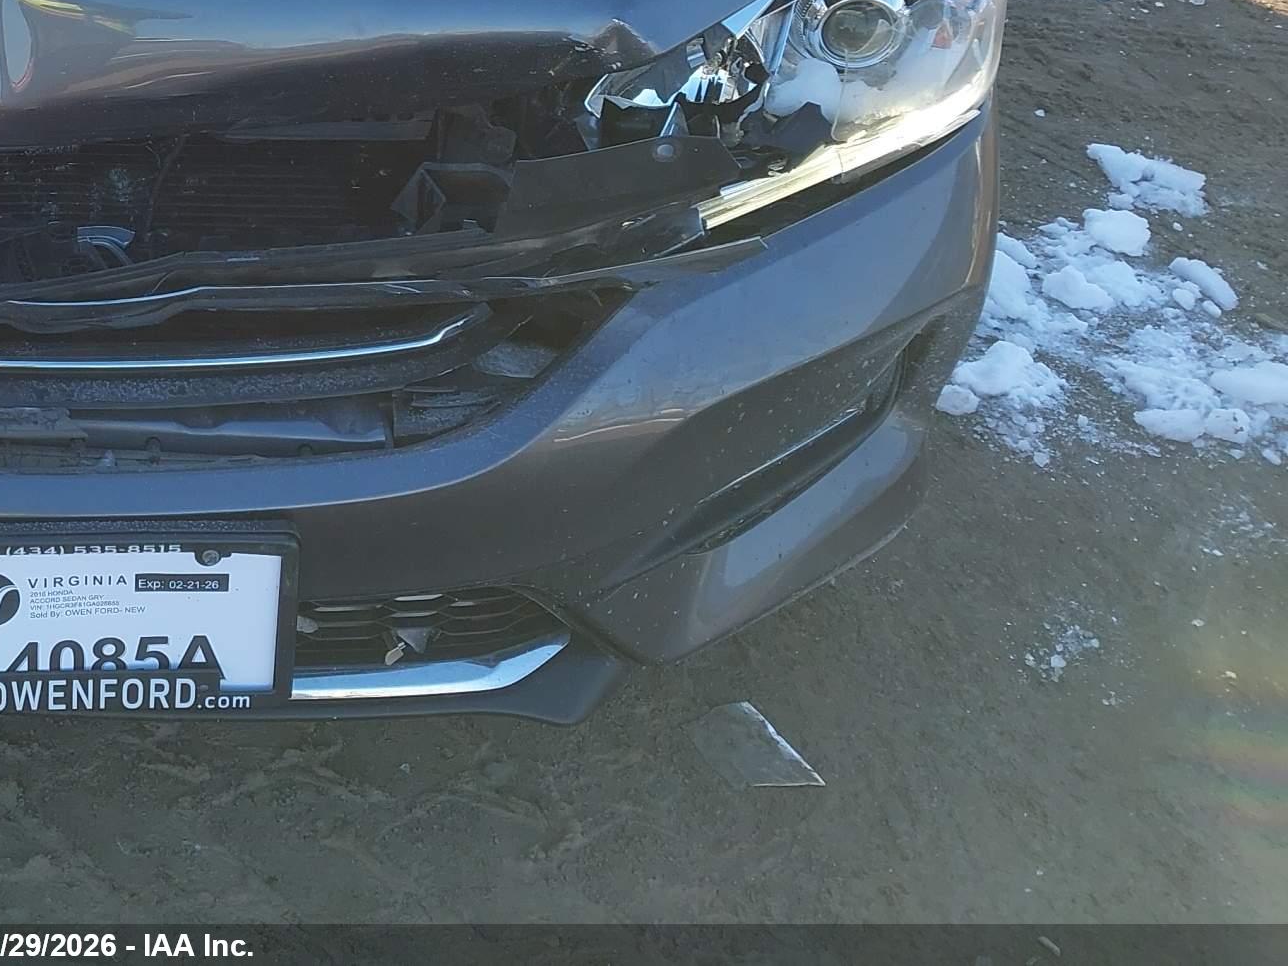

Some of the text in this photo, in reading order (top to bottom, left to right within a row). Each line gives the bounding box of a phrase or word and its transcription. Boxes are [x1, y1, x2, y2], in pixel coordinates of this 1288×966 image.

[73, 544, 182, 555] 535-8515
[28, 575, 127, 588] VIRGINIA
[138, 578, 220, 591] Exp: 02-21-26
[48, 589, 73, 597] HONDA
[62, 595, 87, 603] SEDAN
[30, 611, 48, 619] Sold
[50, 611, 64, 619] By:
[65, 608, 93, 617] OWEN
[125, 606, 146, 614] NEW
